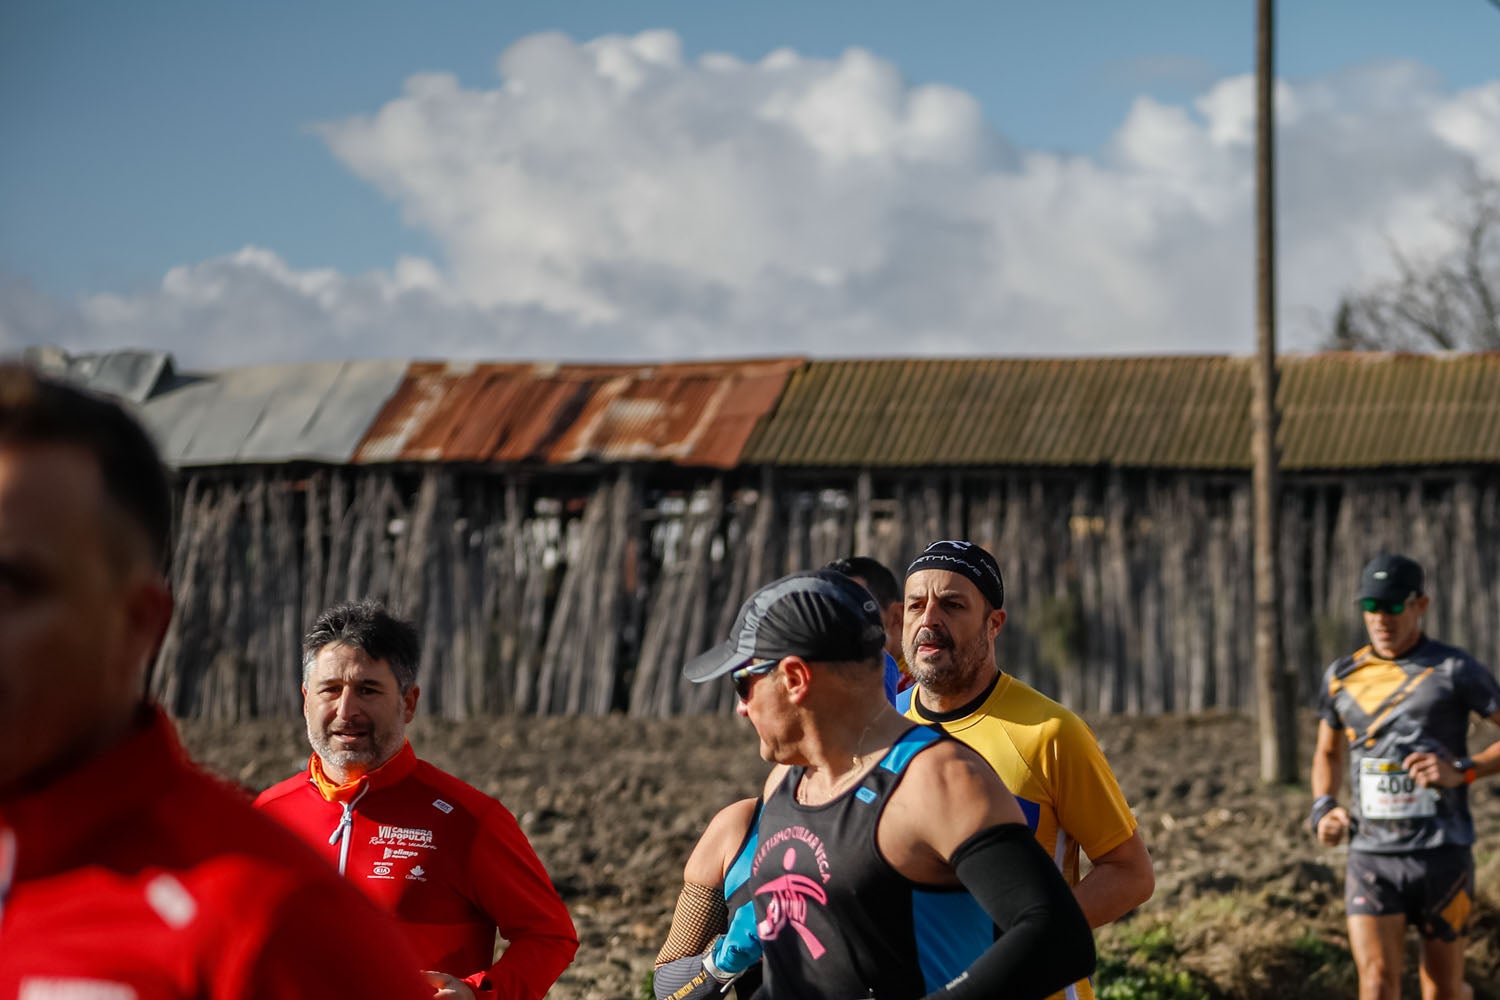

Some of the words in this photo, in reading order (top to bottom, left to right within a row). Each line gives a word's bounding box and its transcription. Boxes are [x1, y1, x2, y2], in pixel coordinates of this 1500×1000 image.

[378, 826, 391, 838] VII
[392, 827, 432, 837] CARRERA
[391, 833, 432, 842] POPULAR
